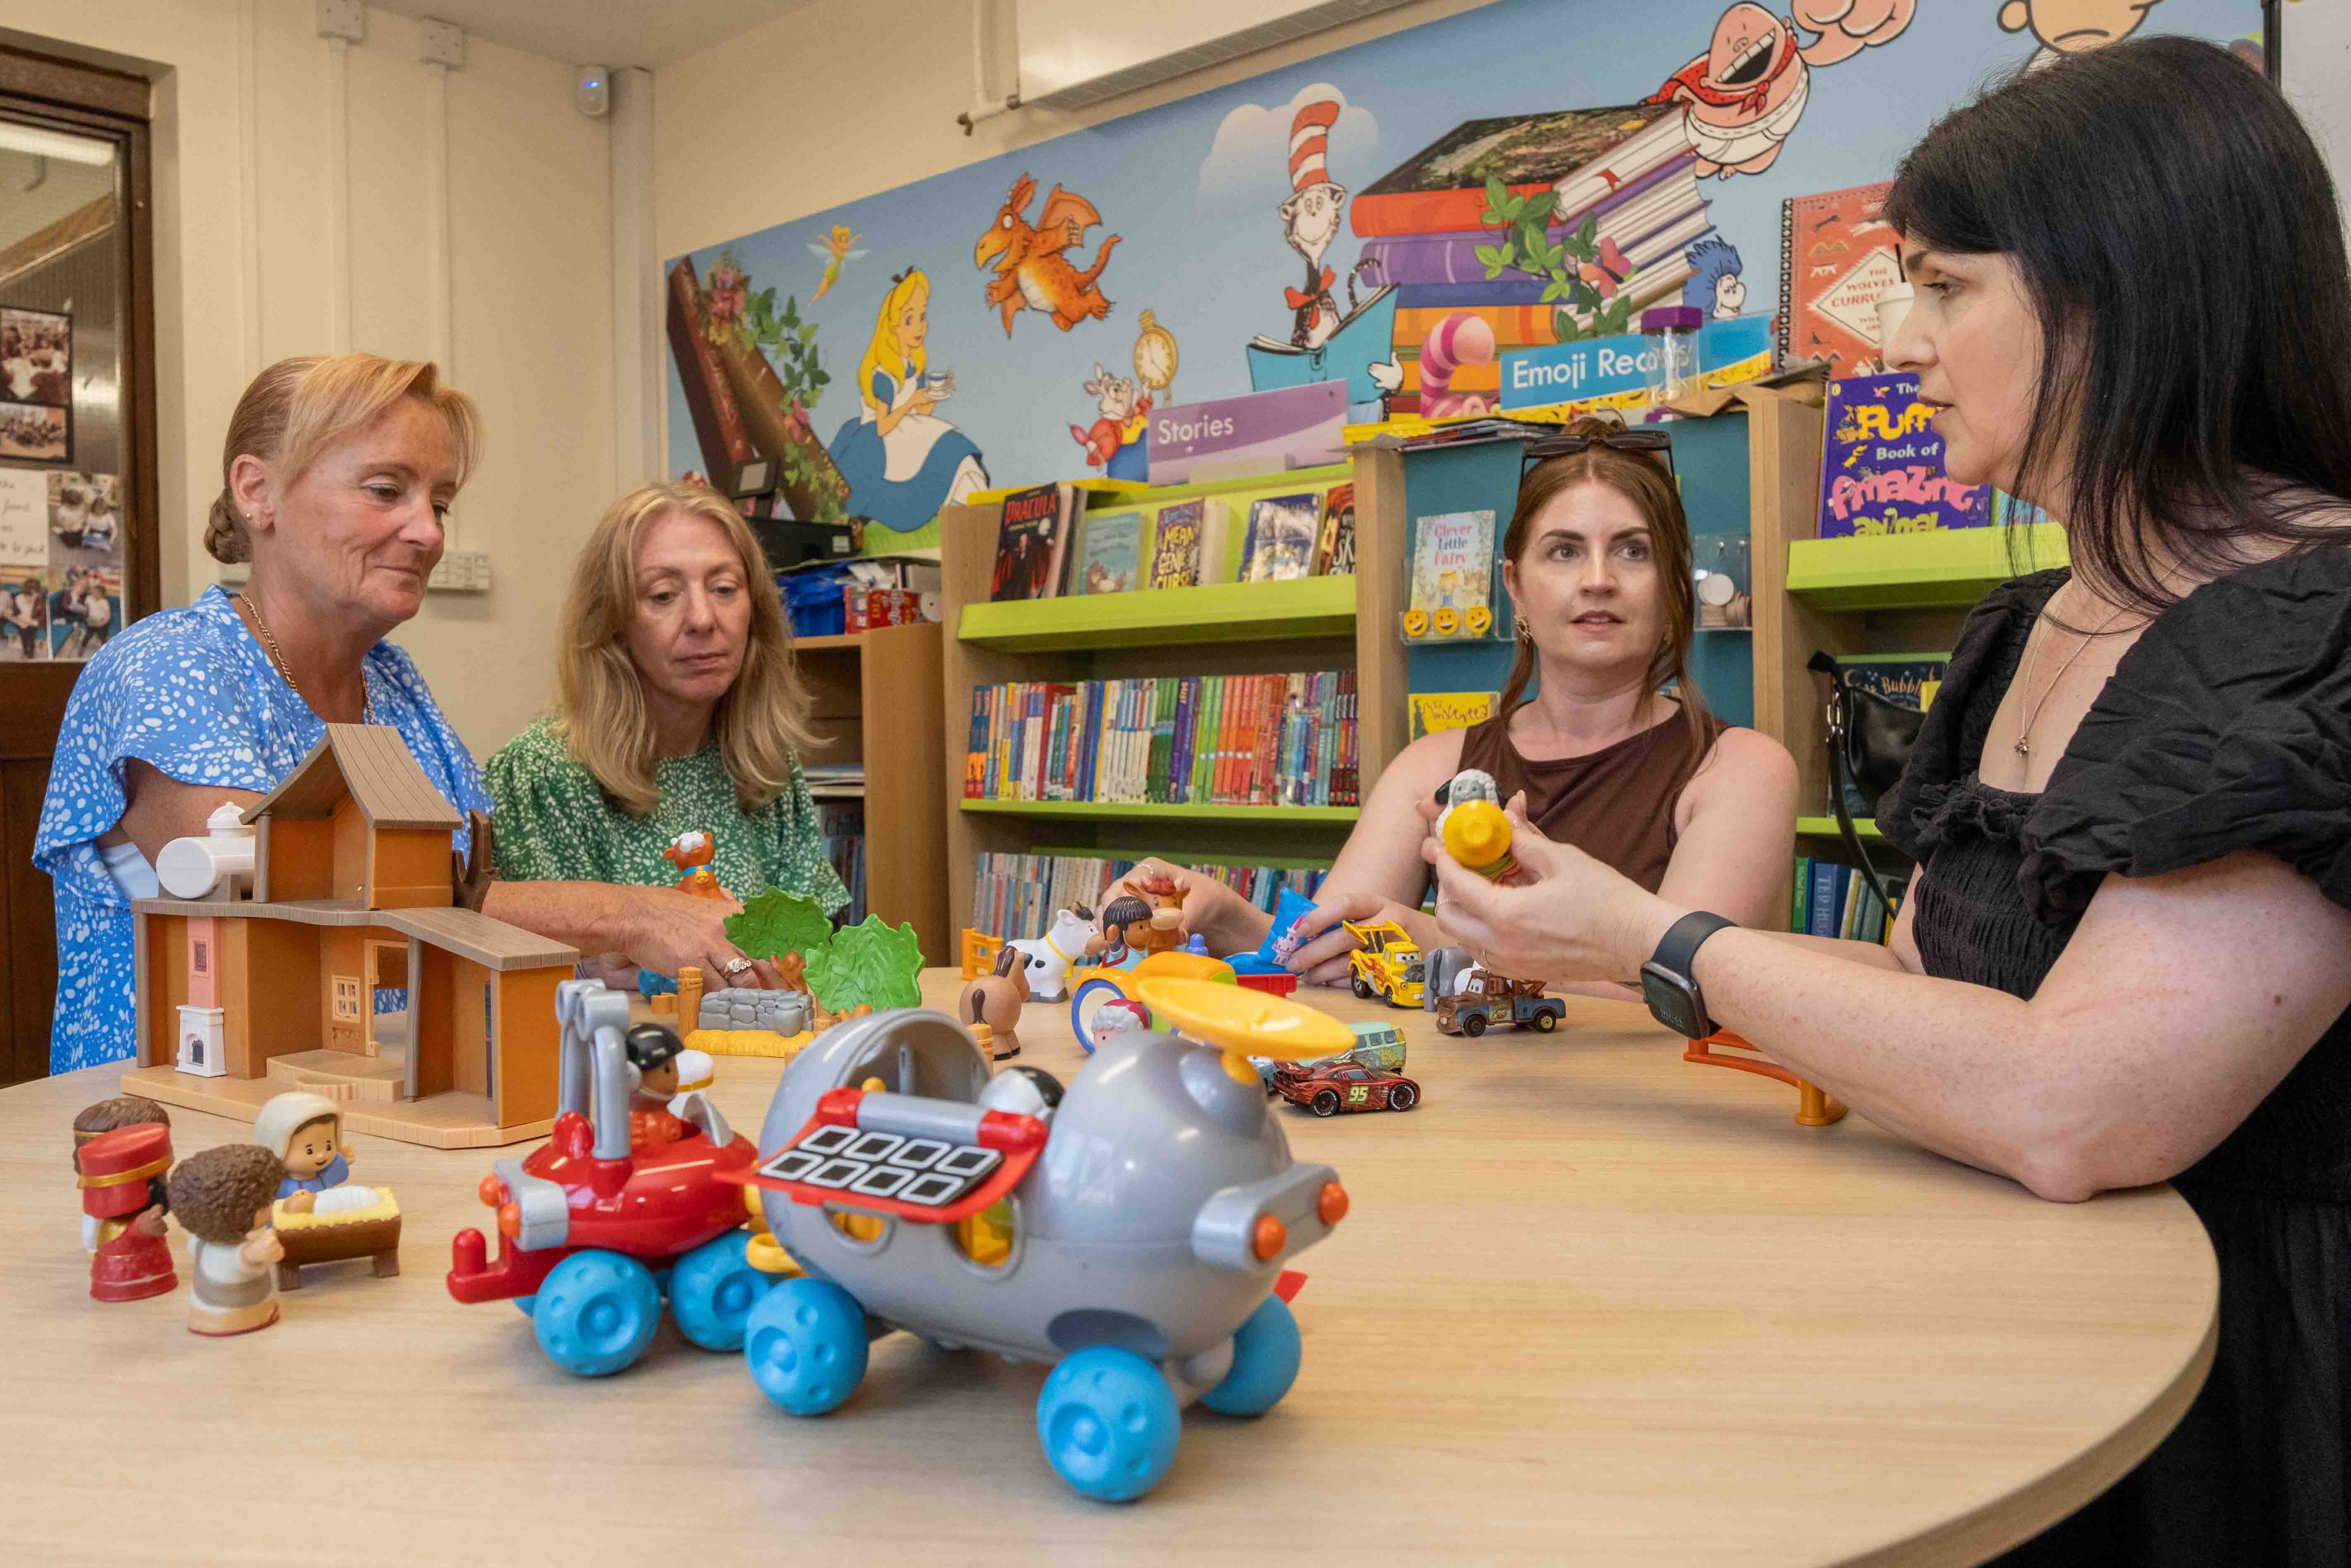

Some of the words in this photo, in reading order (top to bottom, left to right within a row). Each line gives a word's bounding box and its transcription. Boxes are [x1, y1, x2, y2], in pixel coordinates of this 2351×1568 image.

[1870, 267, 1887, 276] THE
[1847, 277, 1895, 291] WOLVES
[1512, 351, 1586, 389] Emoji
[1158, 415, 1234, 445] Stories
[1856, 402, 1937, 440] Puff
[1876, 444, 1916, 461] Book
[1921, 442, 1939, 456] of
[1005, 492, 1056, 527] DRACULA
[1434, 524, 1472, 538] Clever
[1438, 537, 1468, 550] Little
[1435, 551, 1467, 565] Fairy
[1880, 675, 1921, 695] Bubbl
[1348, 1085, 1368, 1103] 95
